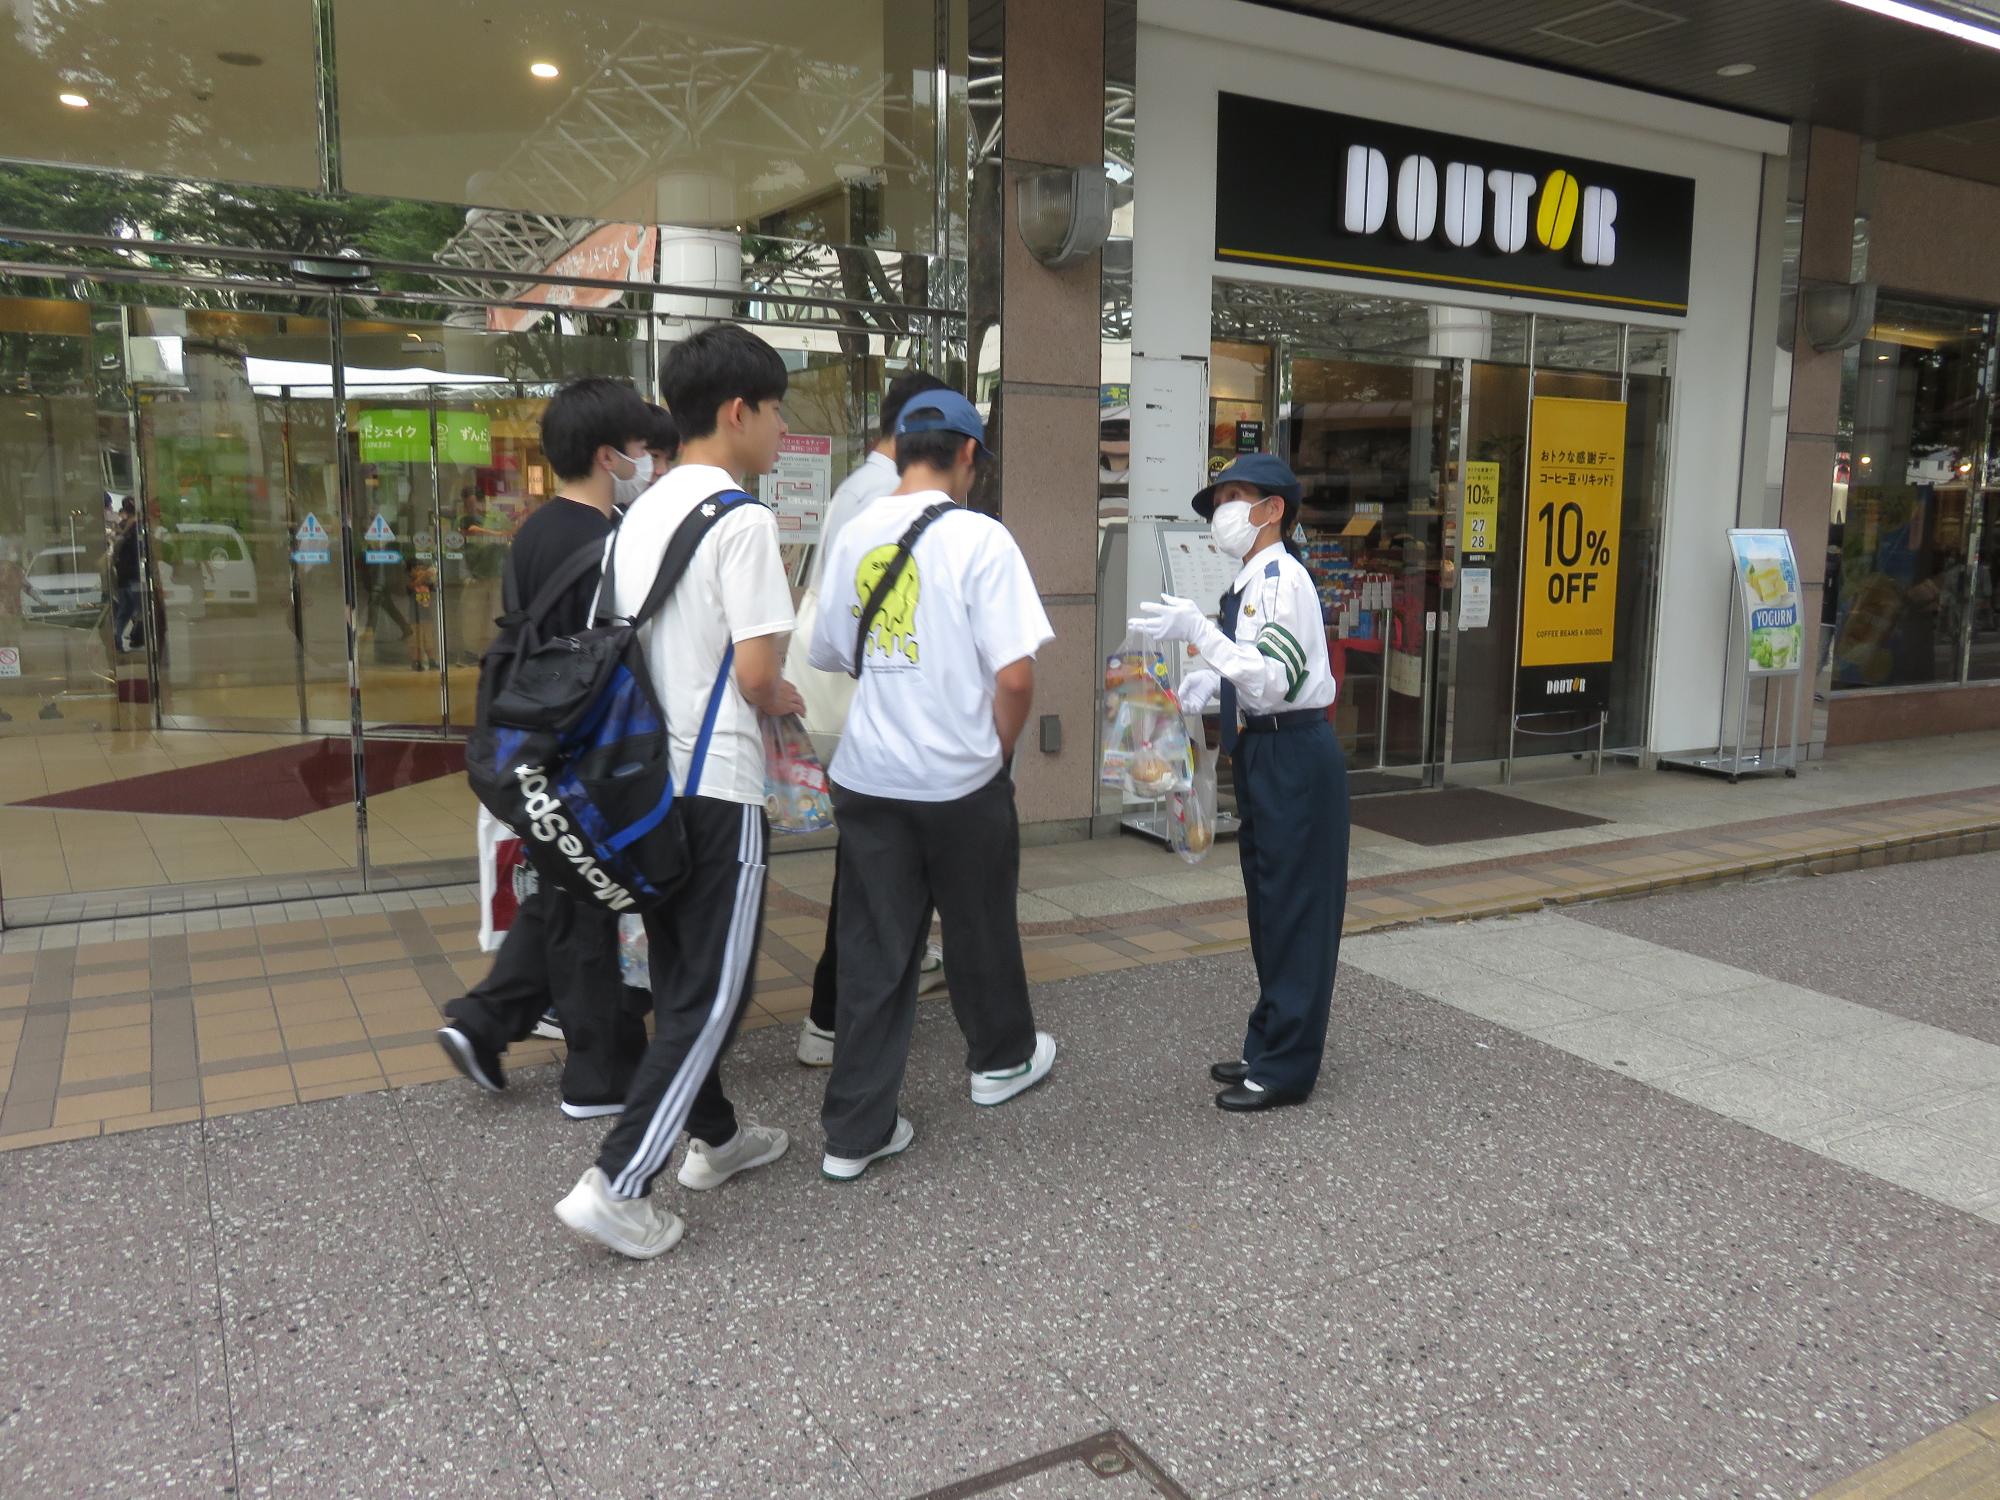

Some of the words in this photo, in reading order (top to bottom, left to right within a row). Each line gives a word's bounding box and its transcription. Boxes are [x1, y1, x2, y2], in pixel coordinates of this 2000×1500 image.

[1344, 143, 1618, 267] DOUTOR
[1541, 450, 1616, 465] おトクな感謝デー
[1481, 497, 1495, 505] OFF
[1472, 519, 1485, 531] 27
[1471, 535, 1485, 548] 28
[1539, 501, 1611, 567] 10%
[1547, 572, 1599, 605] OFF
[1756, 609, 1793, 627] YOGURN
[1536, 629, 1559, 638] COFFEE
[1546, 677, 1586, 695] DOUTOR
